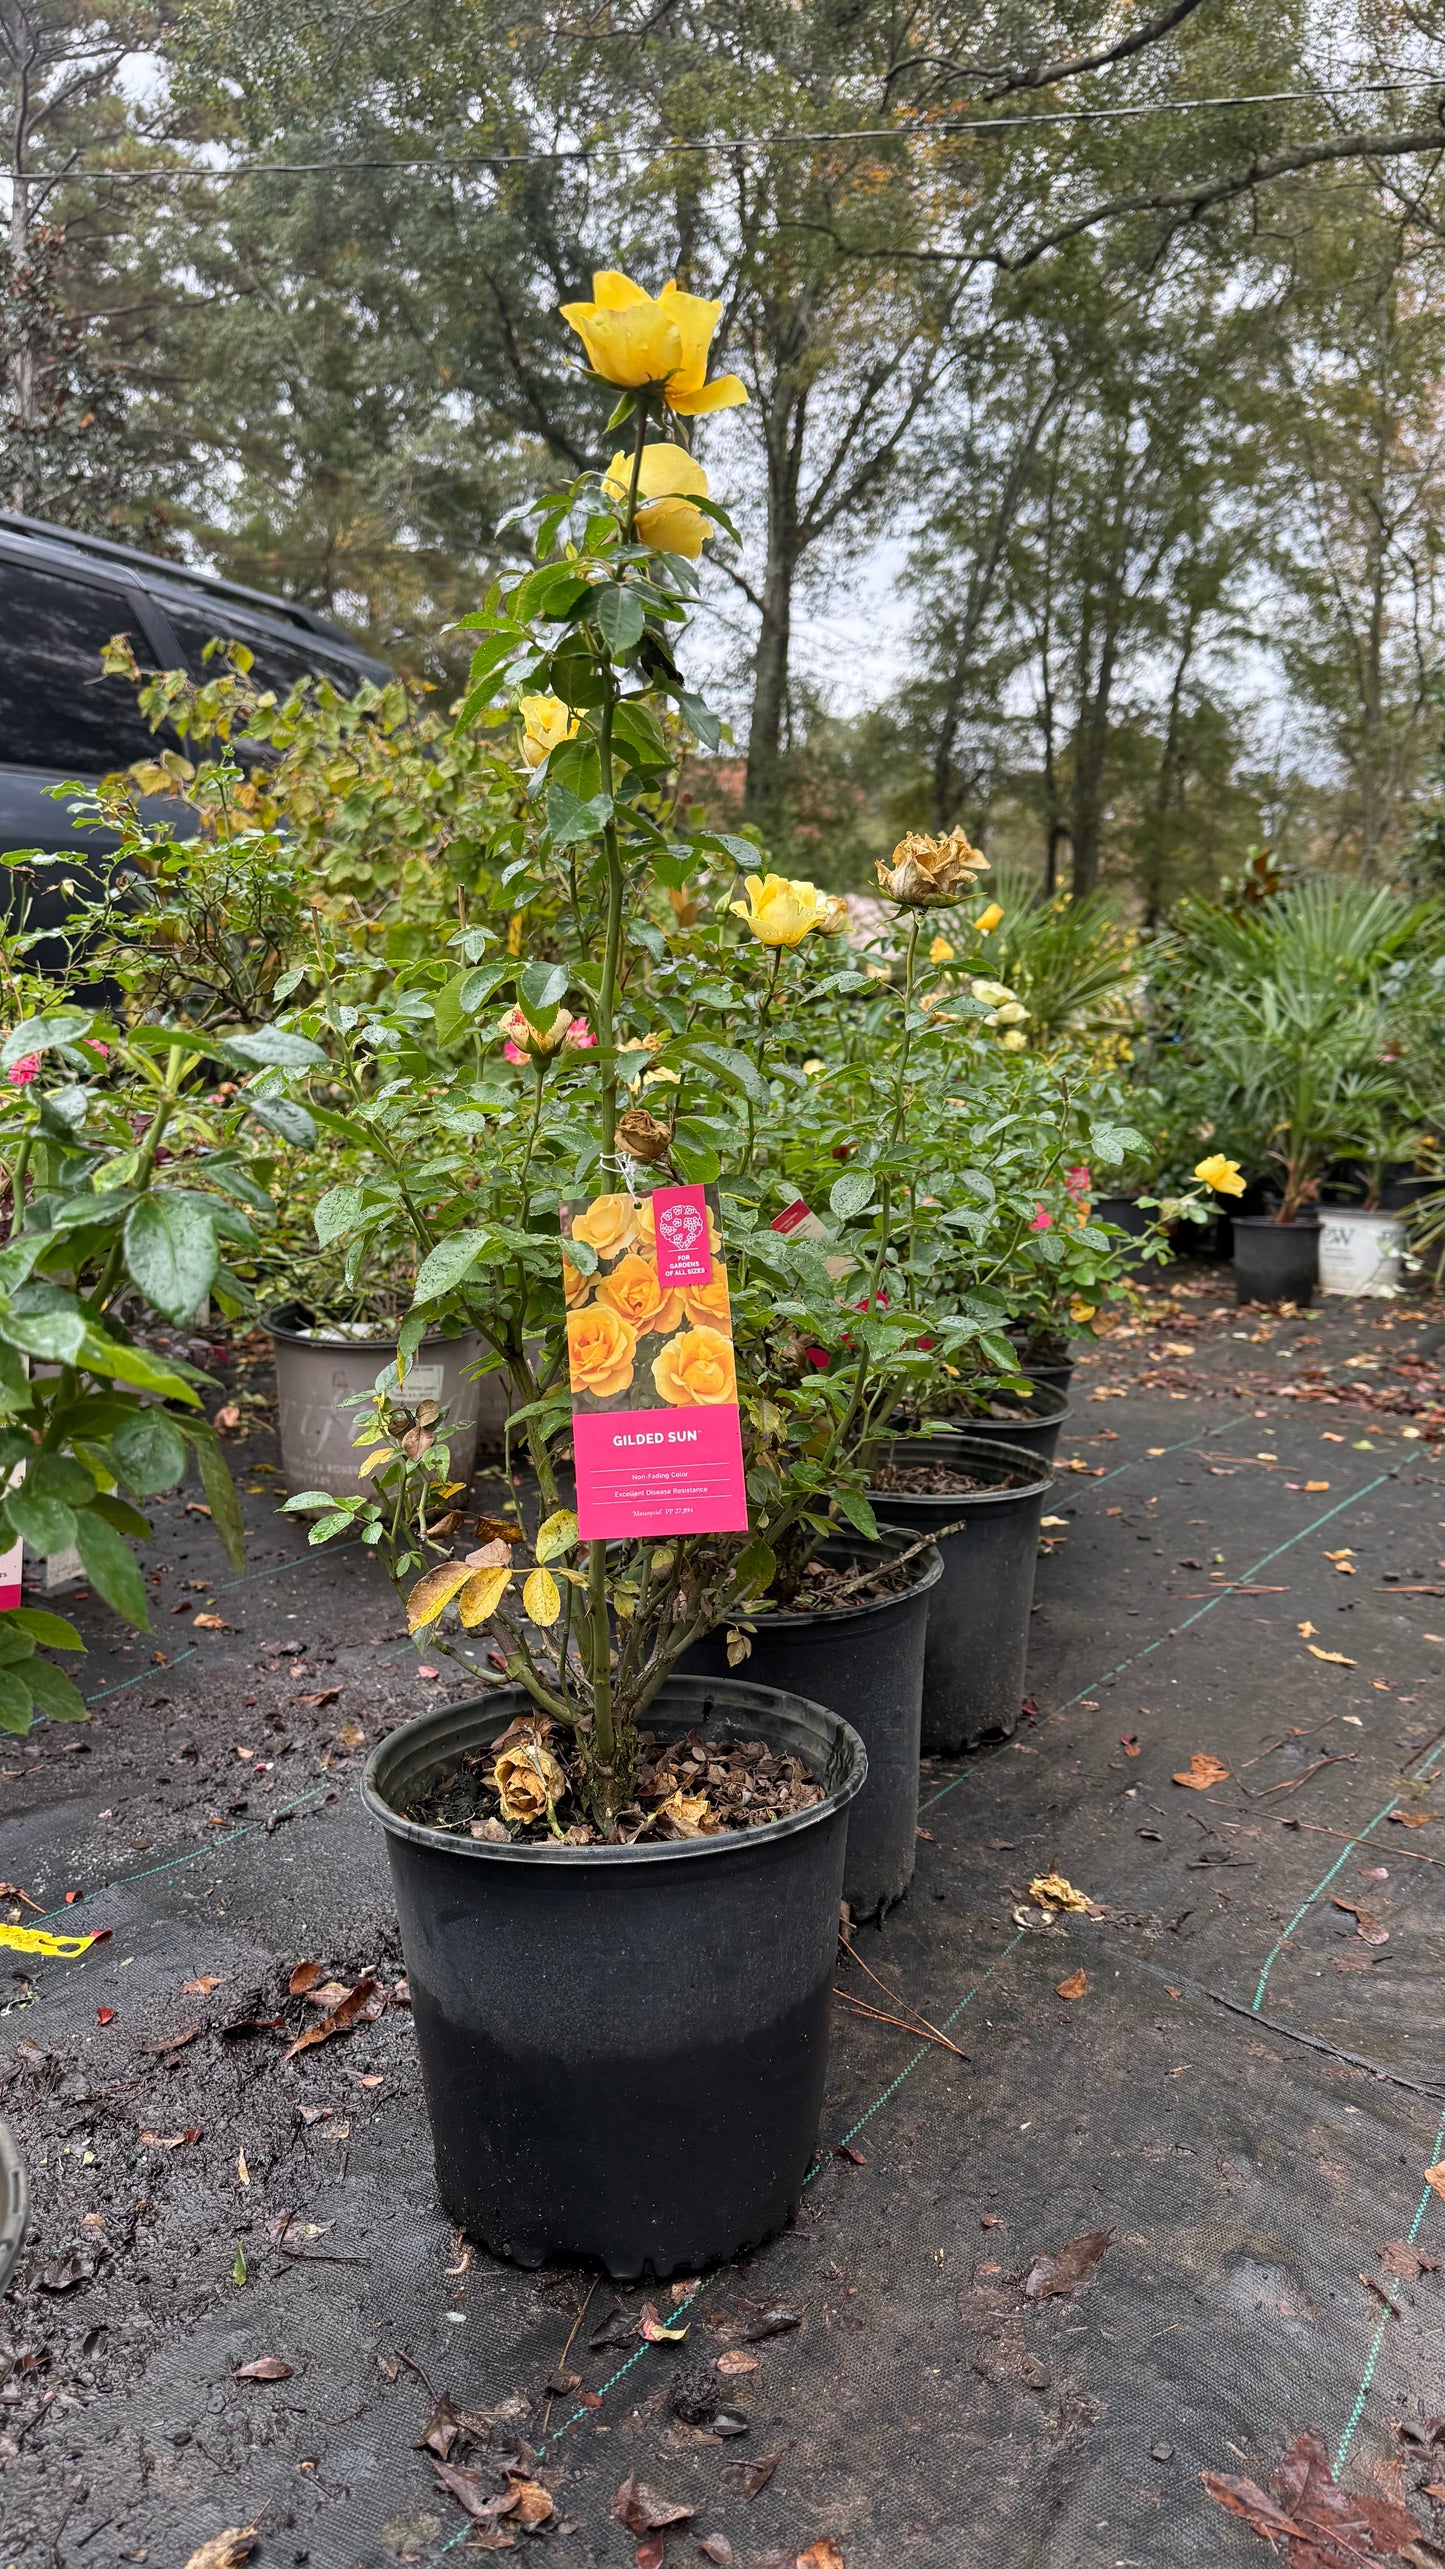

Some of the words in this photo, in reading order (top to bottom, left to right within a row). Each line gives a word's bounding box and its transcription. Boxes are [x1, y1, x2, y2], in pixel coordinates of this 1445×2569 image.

[669, 1261, 700, 1269] GARDENS
[613, 1432, 664, 1446] GILDED
[631, 1472, 670, 1480] Non-Fading
[614, 1489, 645, 1497] Excellent
[646, 1488, 672, 1496] Disease
